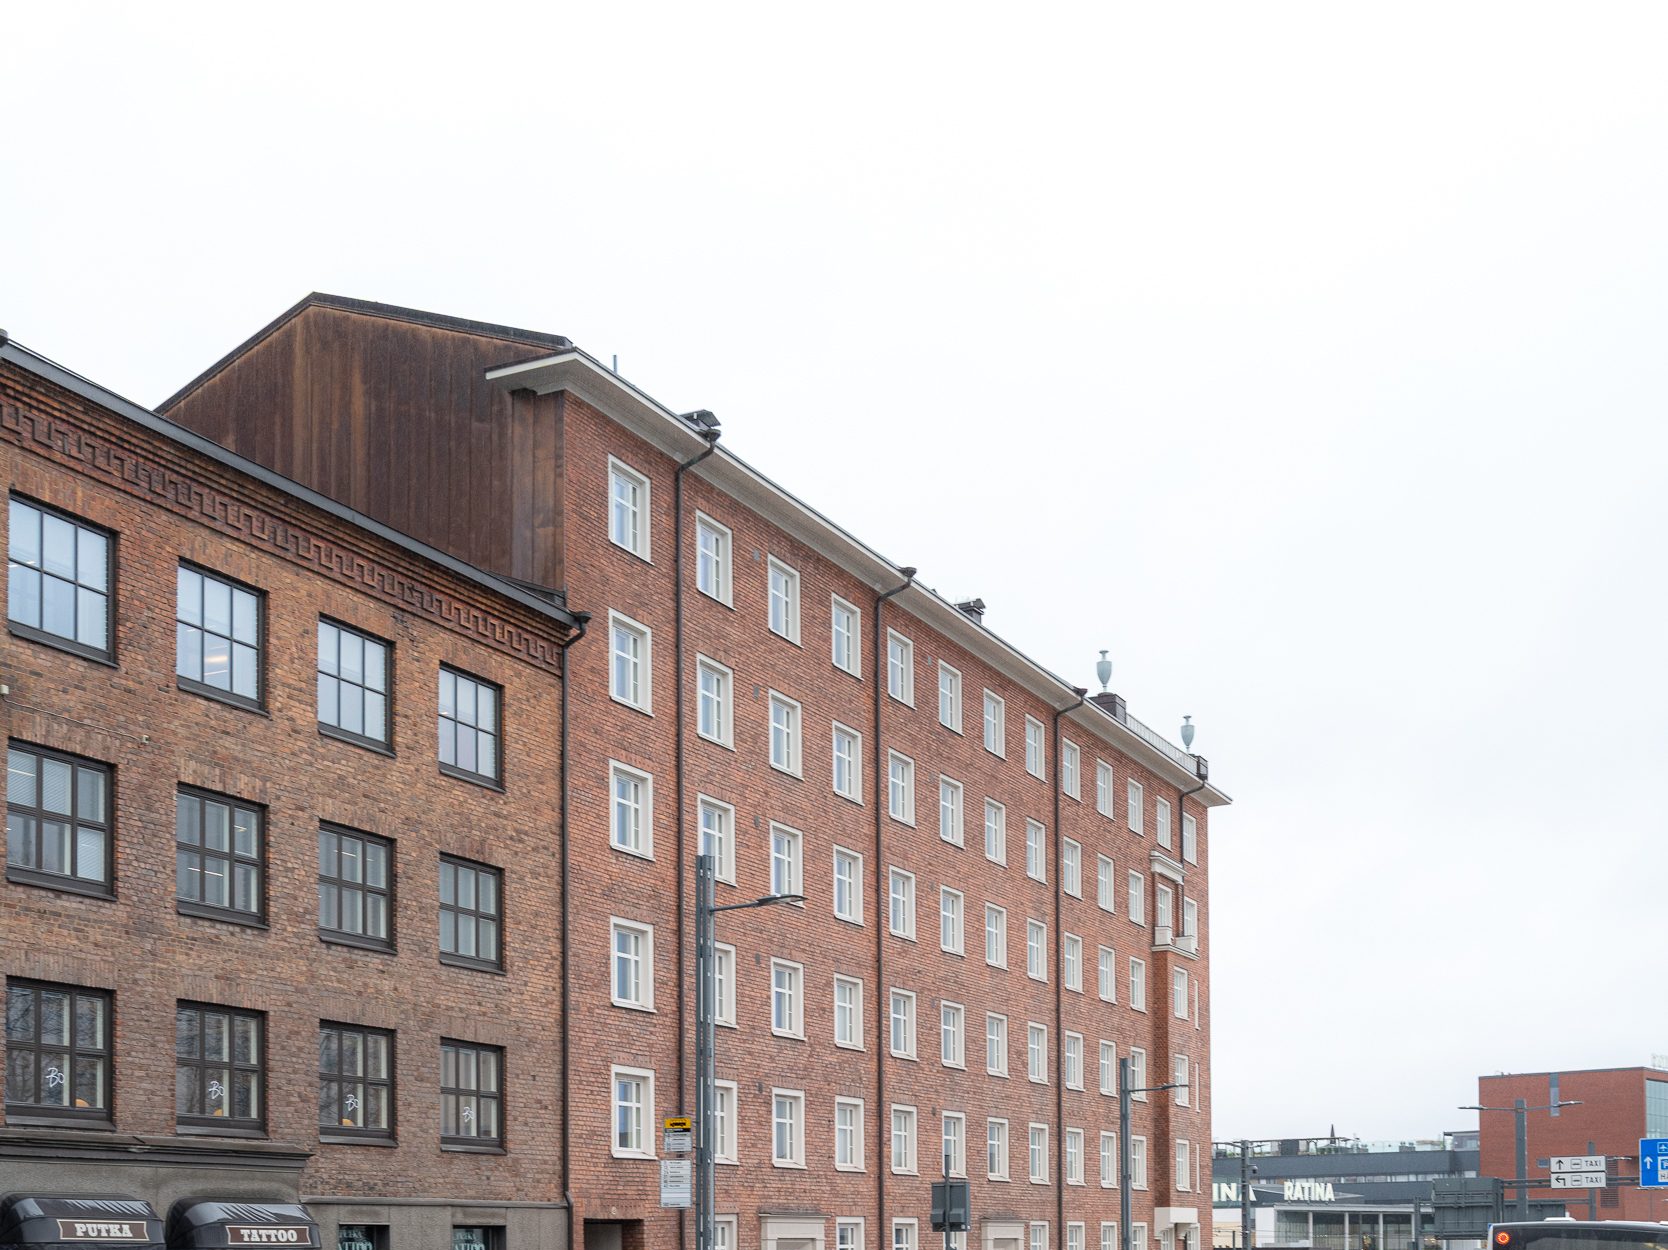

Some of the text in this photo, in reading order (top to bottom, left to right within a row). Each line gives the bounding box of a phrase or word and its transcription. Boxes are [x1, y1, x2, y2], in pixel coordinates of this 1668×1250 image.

[1284, 1181, 1335, 1201] RATINA
[74, 1223, 133, 1238] PUTKA
[240, 1229, 298, 1242] TATTOO
